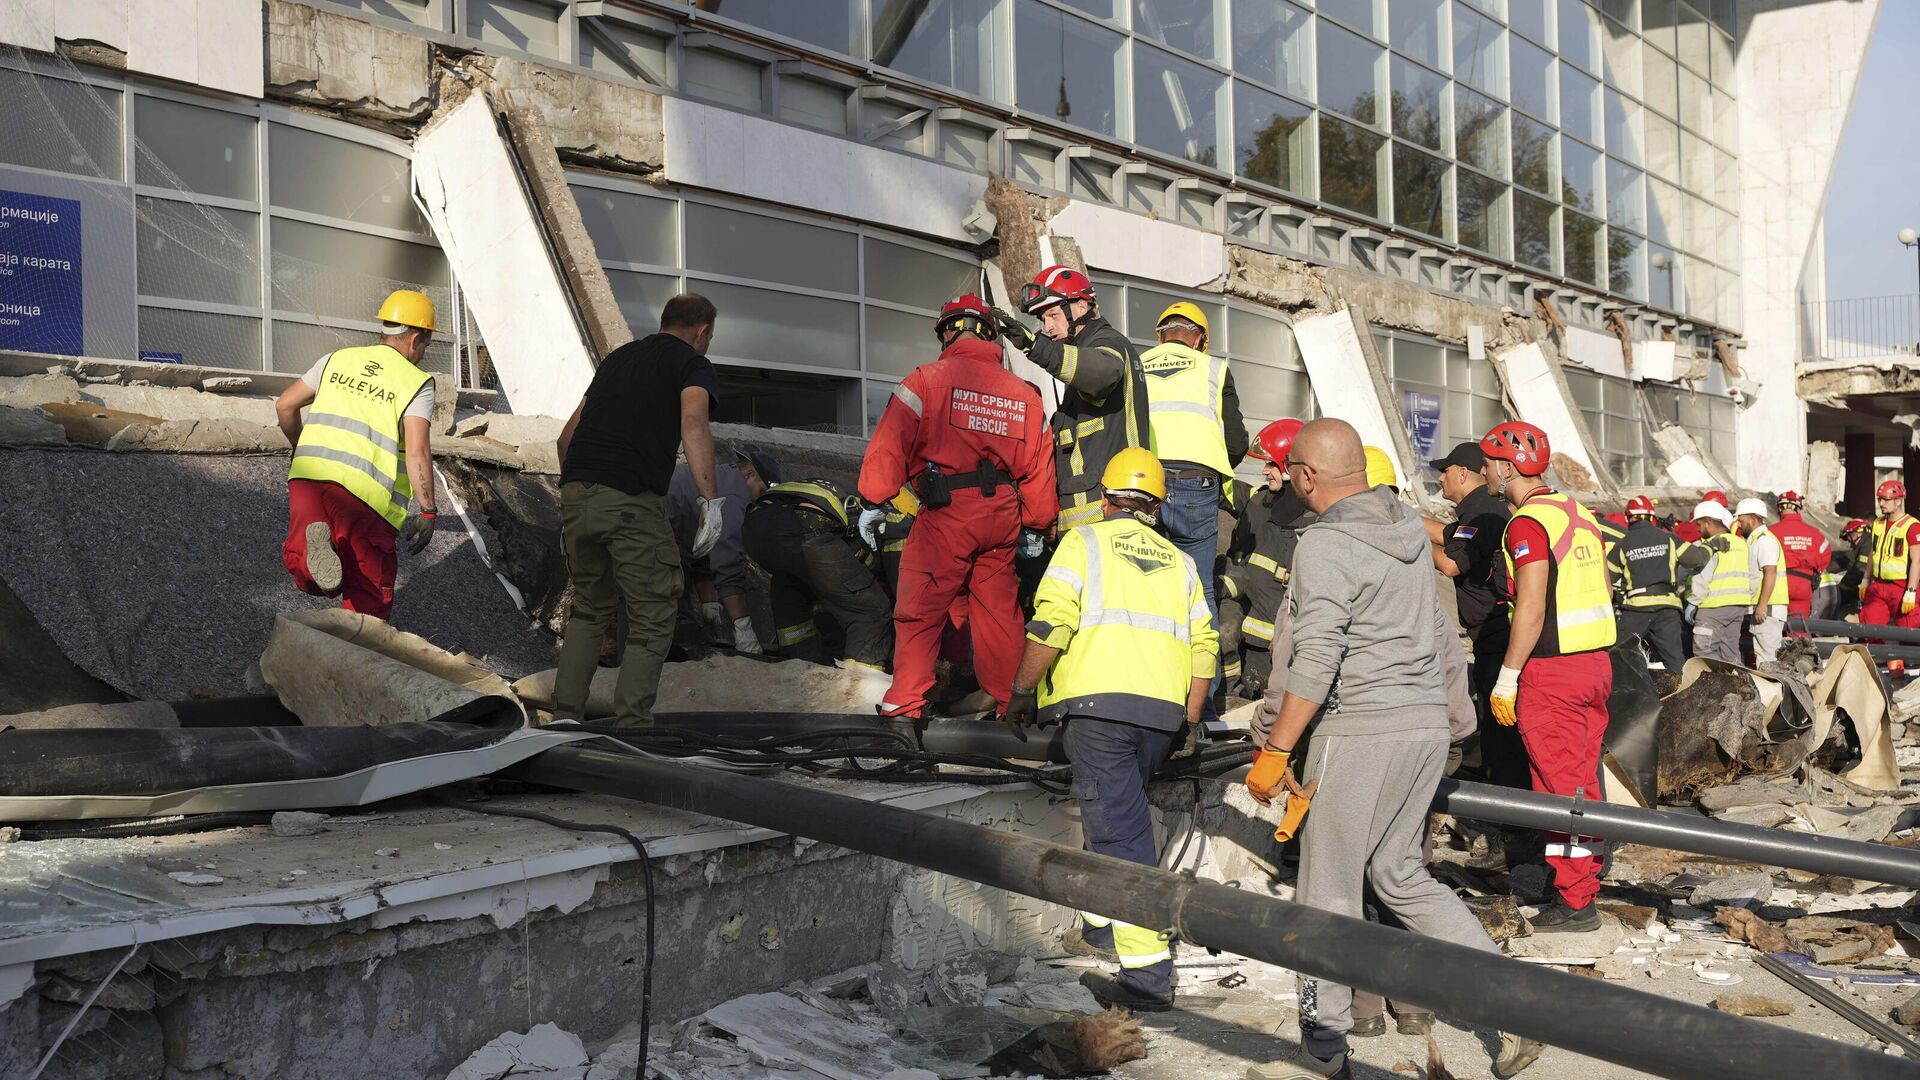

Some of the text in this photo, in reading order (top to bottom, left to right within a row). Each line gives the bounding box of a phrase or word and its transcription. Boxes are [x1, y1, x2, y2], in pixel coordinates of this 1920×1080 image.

[23, 256, 71, 270] карата
[1144, 360, 1193, 369] UT-INVEST
[329, 372, 396, 404] BULEVAR
[953, 388, 1026, 412] МУП СРБИЈЕ
[952, 402, 1025, 422] СПАСИЛАЧКИ ТИМ
[968, 415, 1008, 435] RESCUE
[1115, 541, 1173, 560] PUT-INVEST
